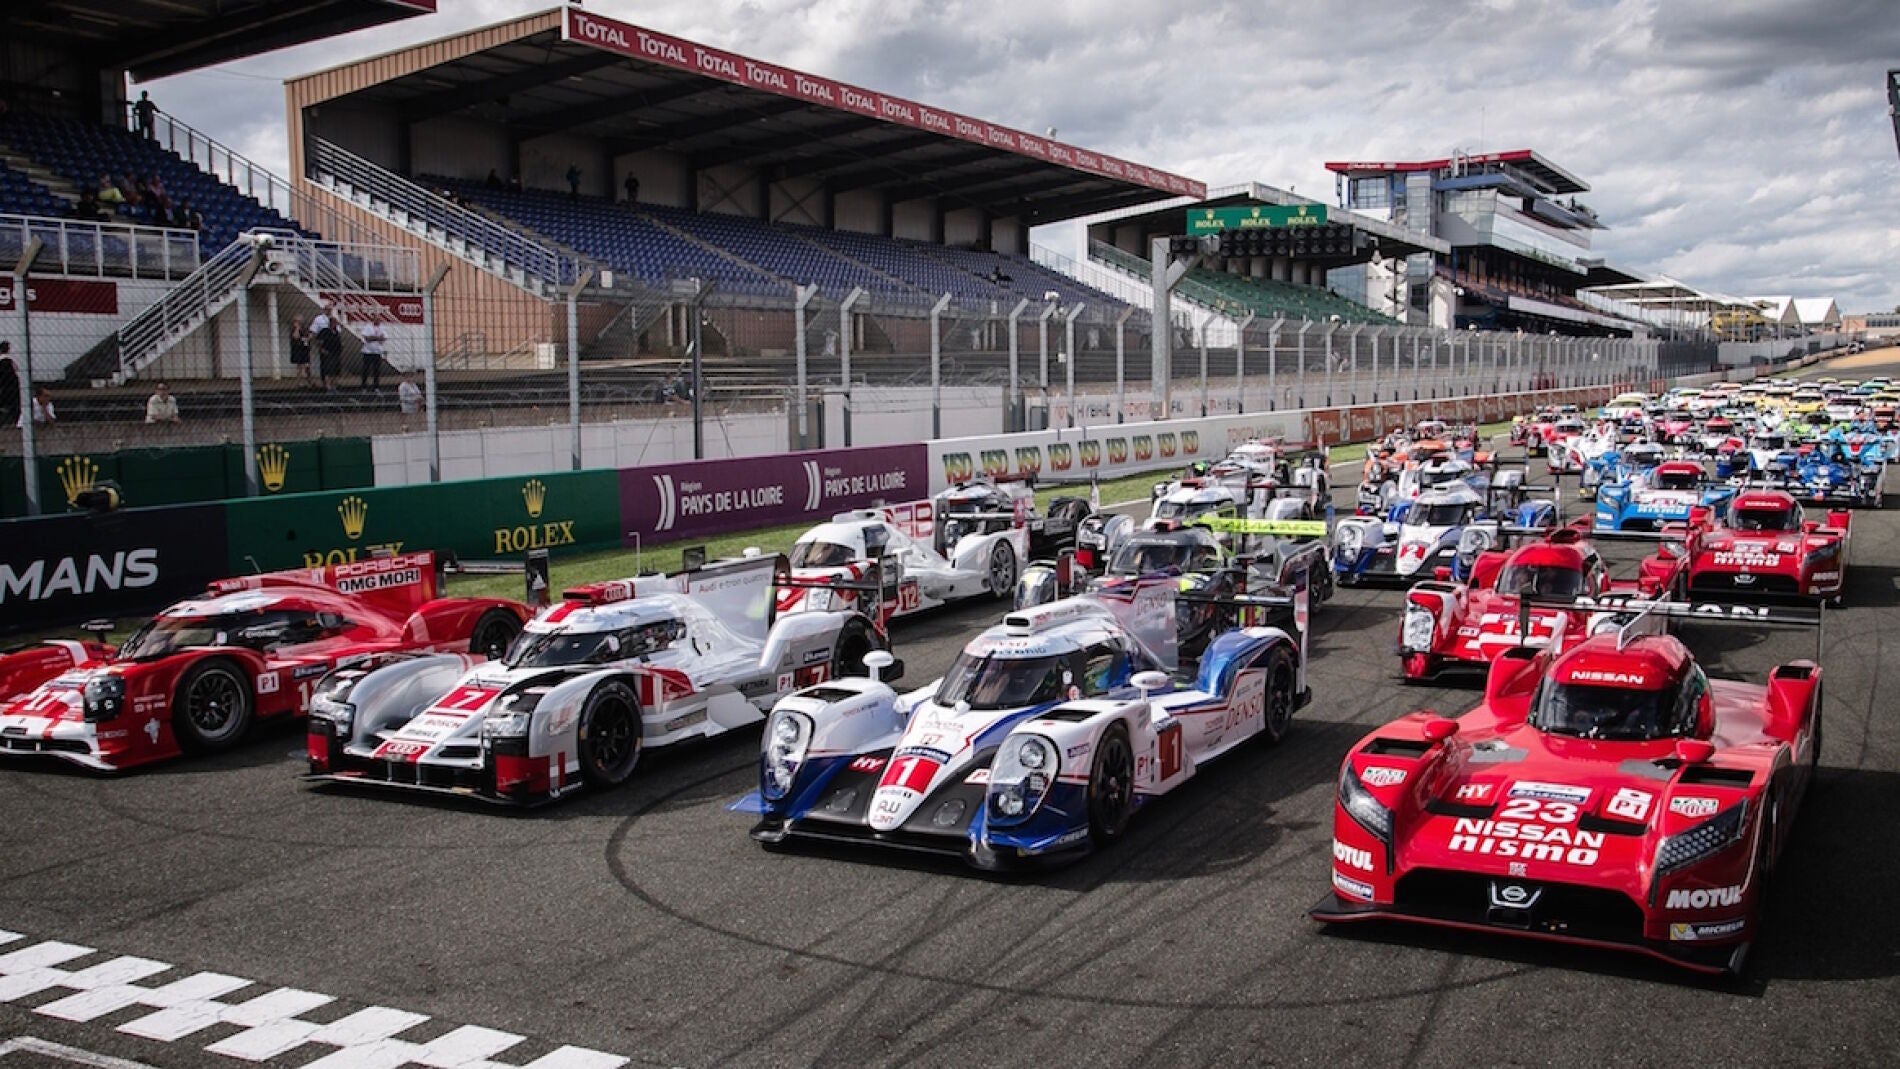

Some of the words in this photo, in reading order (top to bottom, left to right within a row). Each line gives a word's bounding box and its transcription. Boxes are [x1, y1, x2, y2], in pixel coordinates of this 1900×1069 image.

[574, 14, 630, 48] TOTAL
[637, 31, 687, 63] TOTAL
[694, 48, 740, 77] TOTAL
[745, 62, 788, 89] TOTAL
[794, 75, 834, 100] TOTAL
[840, 87, 876, 111] TOTAL
[880, 98, 914, 120] TOTAL
[919, 108, 950, 130] TOTAL
[955, 117, 983, 138] TOTAL
[987, 126, 1015, 146] TOTAL
[1019, 135, 1044, 154] TOTAL
[1195, 219, 1224, 229] ROLEX
[1240, 217, 1271, 227] ROLEX
[1287, 215, 1318, 225] ROLEX
[826, 478, 849, 497] PAYS
[852, 476, 864, 494] DE
[867, 474, 878, 492] LA
[880, 471, 905, 490] LOIRE
[682, 494, 713, 516] PAYS
[715, 491, 731, 512] DE
[734, 490, 749, 509] LA
[751, 486, 783, 507] LOIRE
[494, 520, 576, 554] ROLEX
[335, 553, 432, 576] PORSCHE
[0, 548, 159, 604] MANS
[379, 568, 420, 586] MORI
[262, 676, 276, 690] P1
[780, 675, 792, 690] P1
[811, 665, 825, 685] 7
[1570, 671, 1645, 685] NISSAN
[451, 691, 486, 710] 7
[1171, 732, 1179, 770] 1
[852, 756, 884, 769] HY
[896, 758, 920, 786] 1
[1137, 755, 1149, 777] P1
[1456, 784, 1492, 799] HY
[1500, 799, 1577, 824] 23
[1614, 800, 1643, 816] P1
[1454, 818, 1605, 849] NISSAN
[1665, 885, 1742, 909] MOTUL
[1698, 920, 1745, 935] MICHELIN
